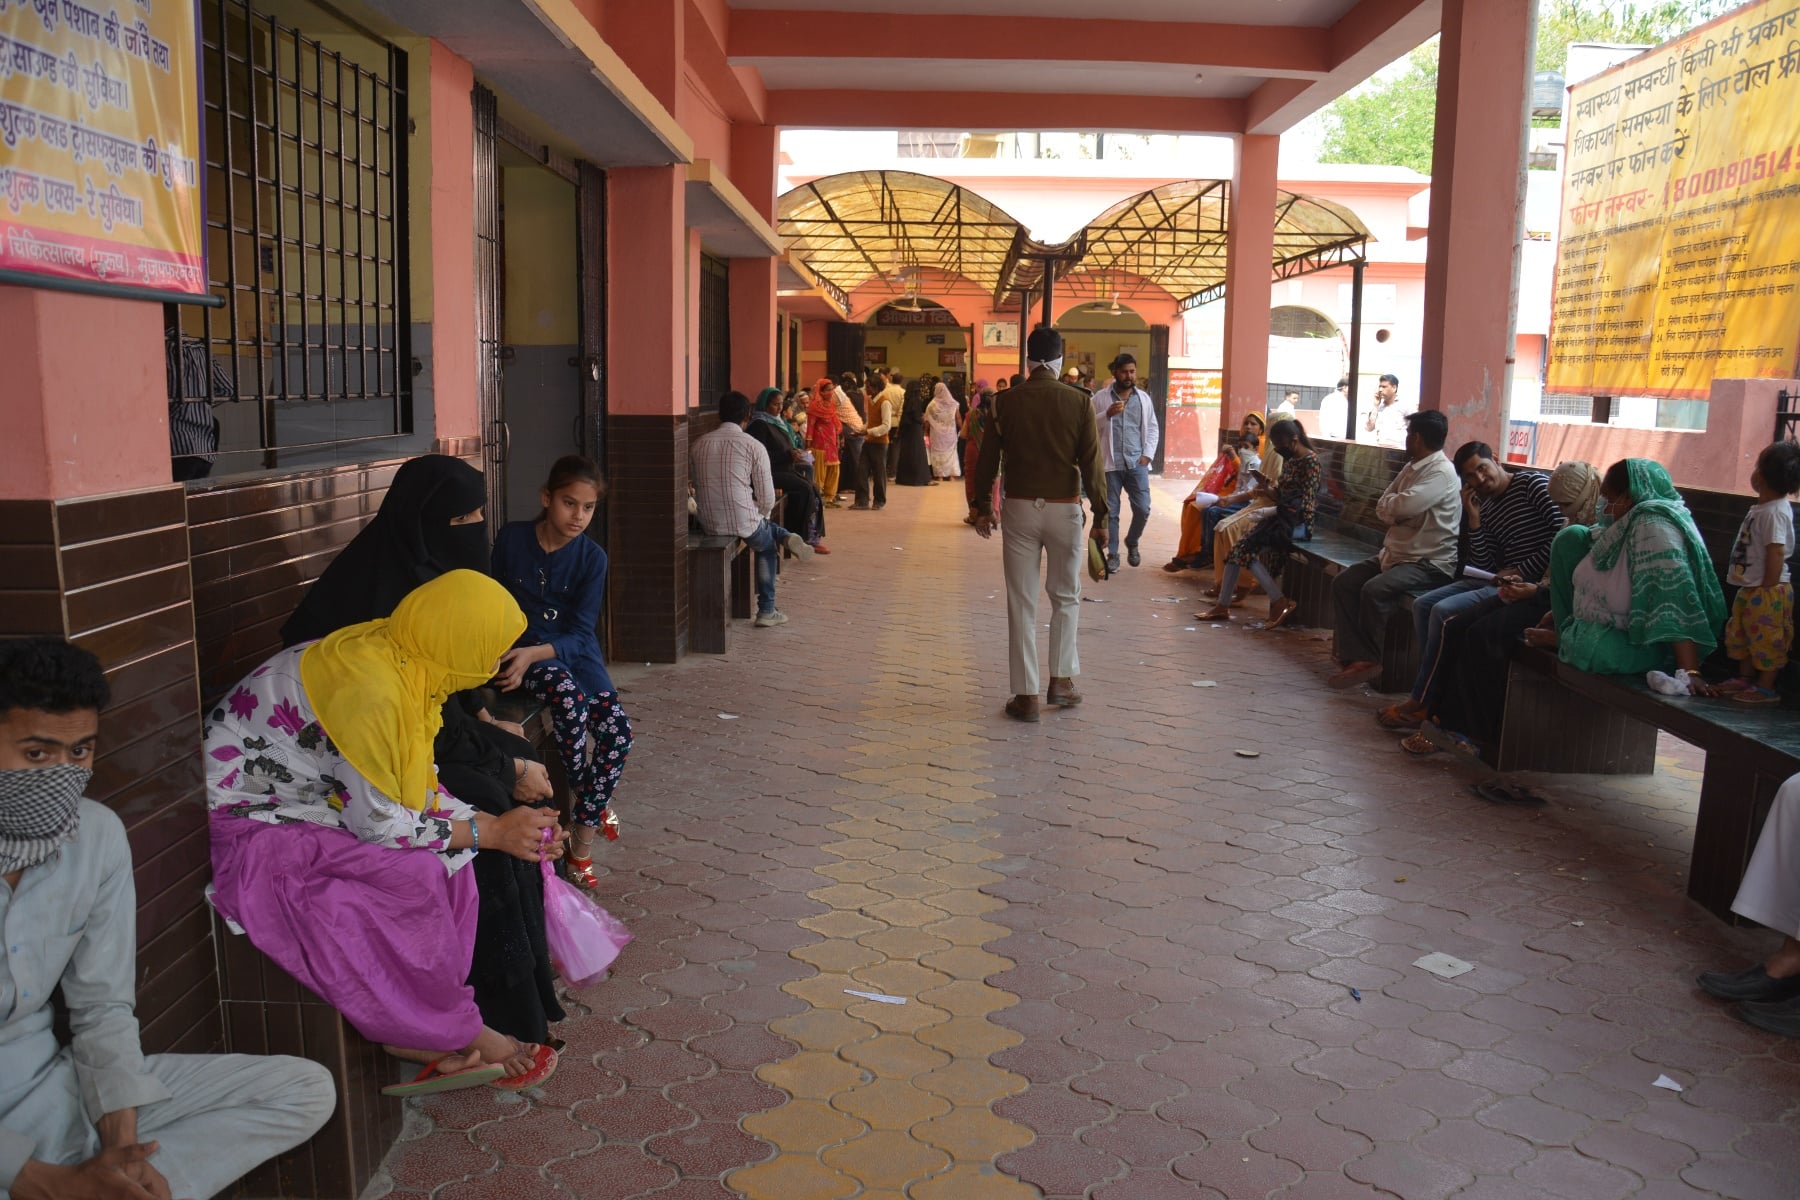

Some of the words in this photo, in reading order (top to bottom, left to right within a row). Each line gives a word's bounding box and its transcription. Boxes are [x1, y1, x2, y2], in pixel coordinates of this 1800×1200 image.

[1680, 39, 1717, 78] किसी
[1721, 26, 1744, 56] भी
[1746, 7, 1800, 48] प्रकार
[59, 52, 79, 90] की
[1677, 84, 1695, 116] के
[1698, 77, 1731, 112] लिए
[1734, 58, 1775, 94] टोल
[142, 138, 158, 174] की
[1607, 157, 1626, 179] पर
[1628, 141, 1660, 174] फोन
[1661, 128, 1690, 165] करें
[1570, 197, 1603, 226] फोन
[1509, 431, 1528, 447] 2020
